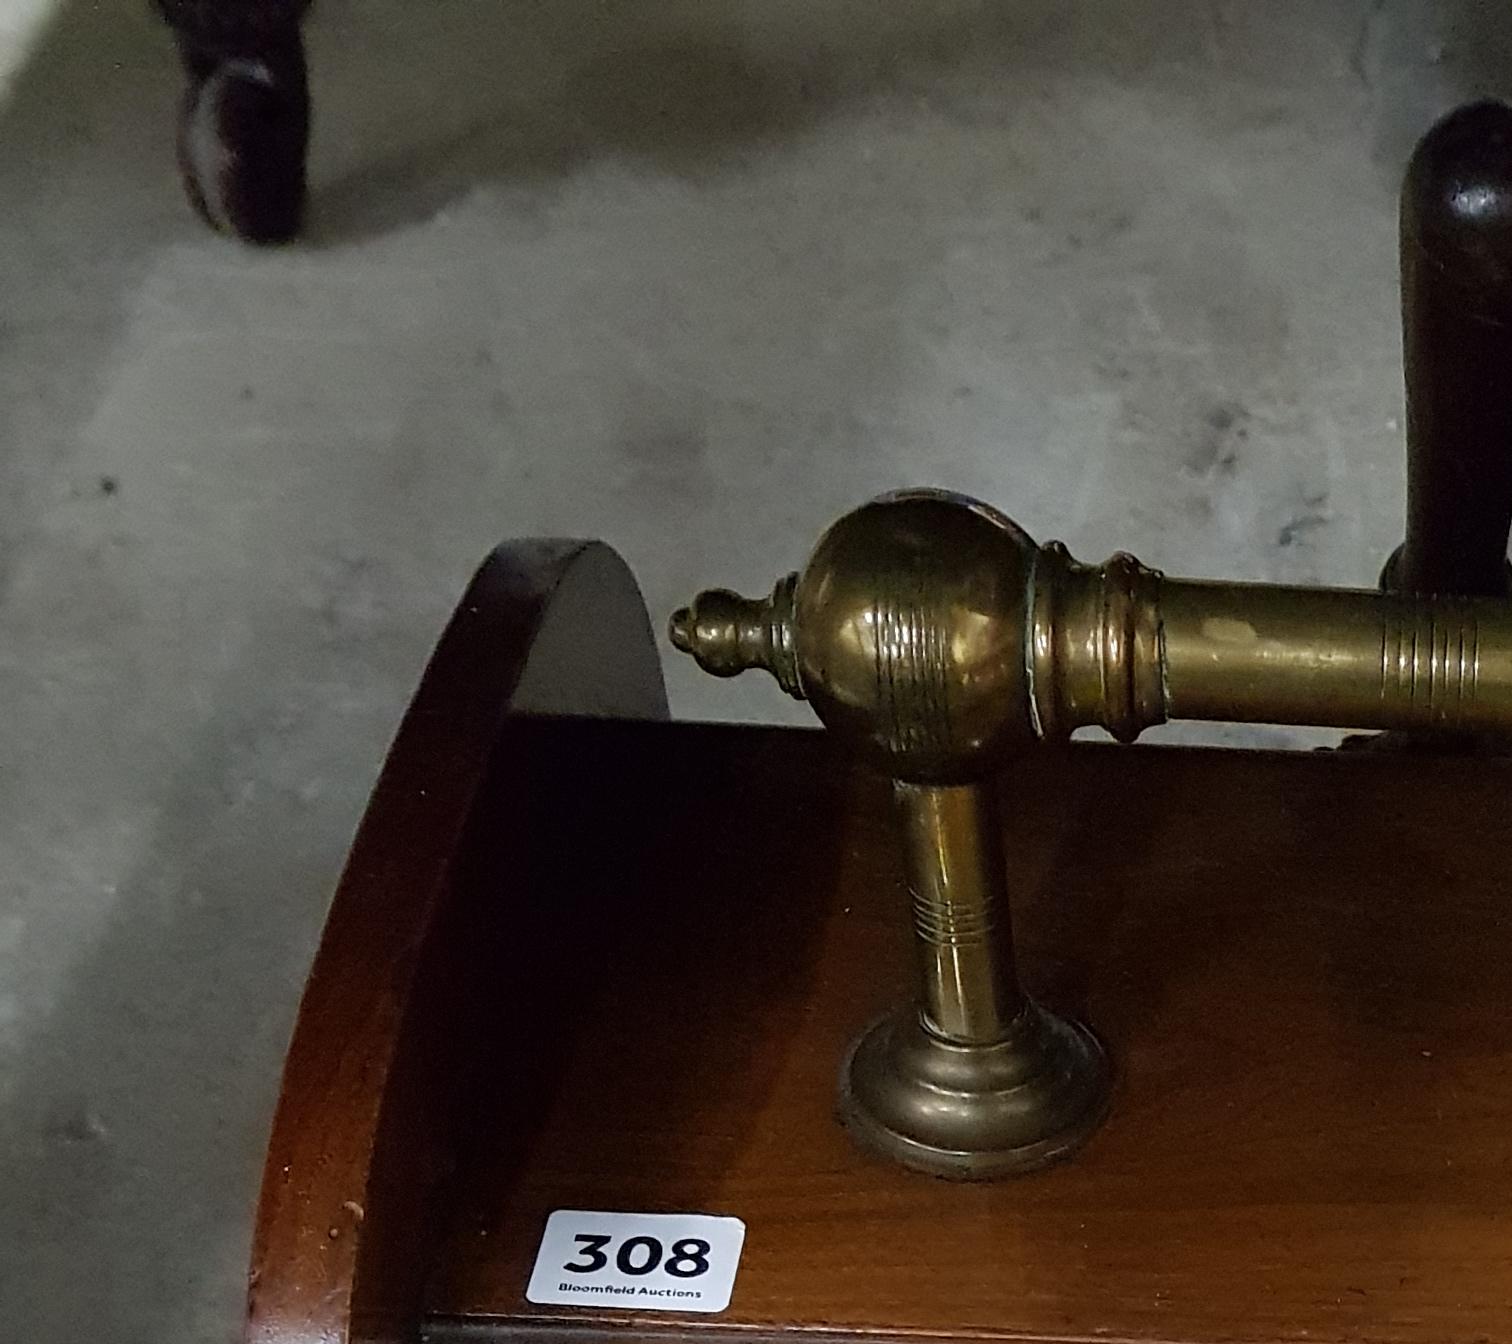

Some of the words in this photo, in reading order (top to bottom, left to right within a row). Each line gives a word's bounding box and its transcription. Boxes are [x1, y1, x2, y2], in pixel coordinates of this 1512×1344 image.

[563, 1233, 711, 1278] 308
[558, 1282, 636, 1296] Bloomfield
[638, 1286, 702, 1299] Auctions
